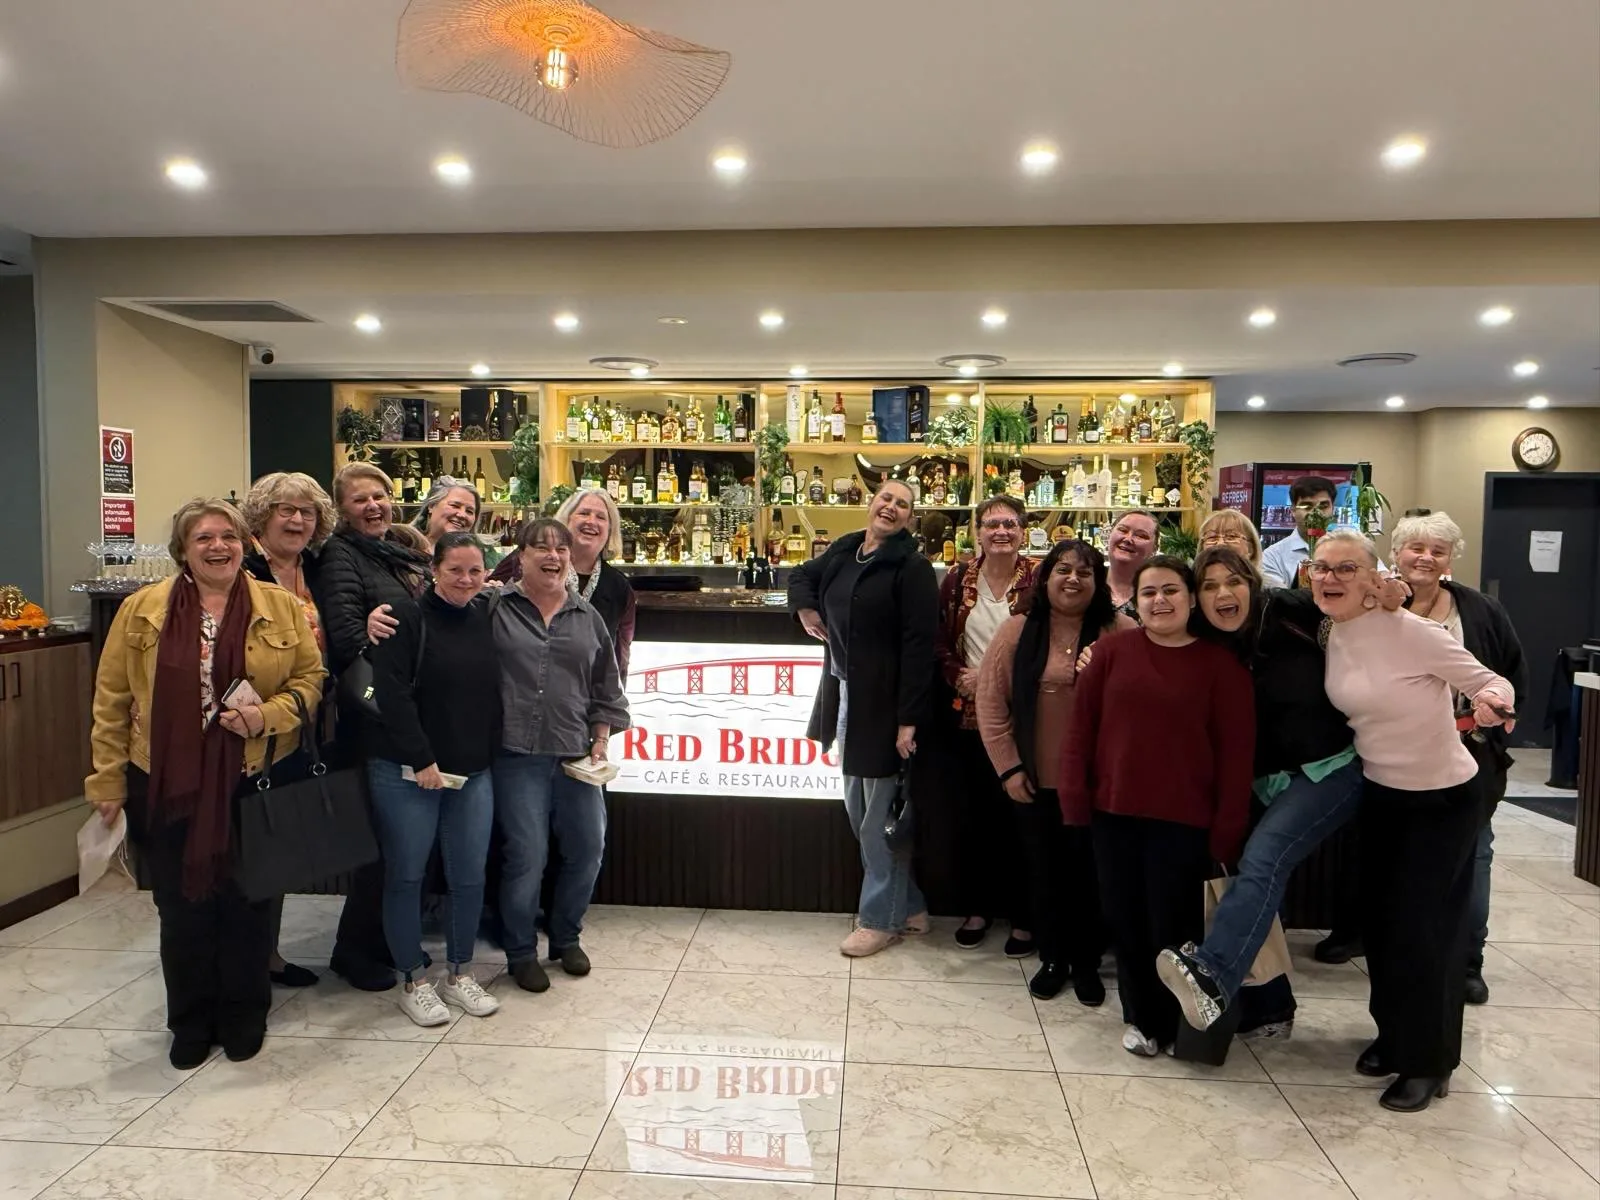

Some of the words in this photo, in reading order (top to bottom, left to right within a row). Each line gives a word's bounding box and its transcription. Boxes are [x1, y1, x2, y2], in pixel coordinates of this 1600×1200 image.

[1221, 490, 1248, 504] REFRESH
[104, 523, 121, 531] testing
[621, 726, 702, 762] RED
[644, 769, 690, 784] CAFÉ
[698, 772, 710, 785] &
[718, 772, 841, 790] RESTAURANT
